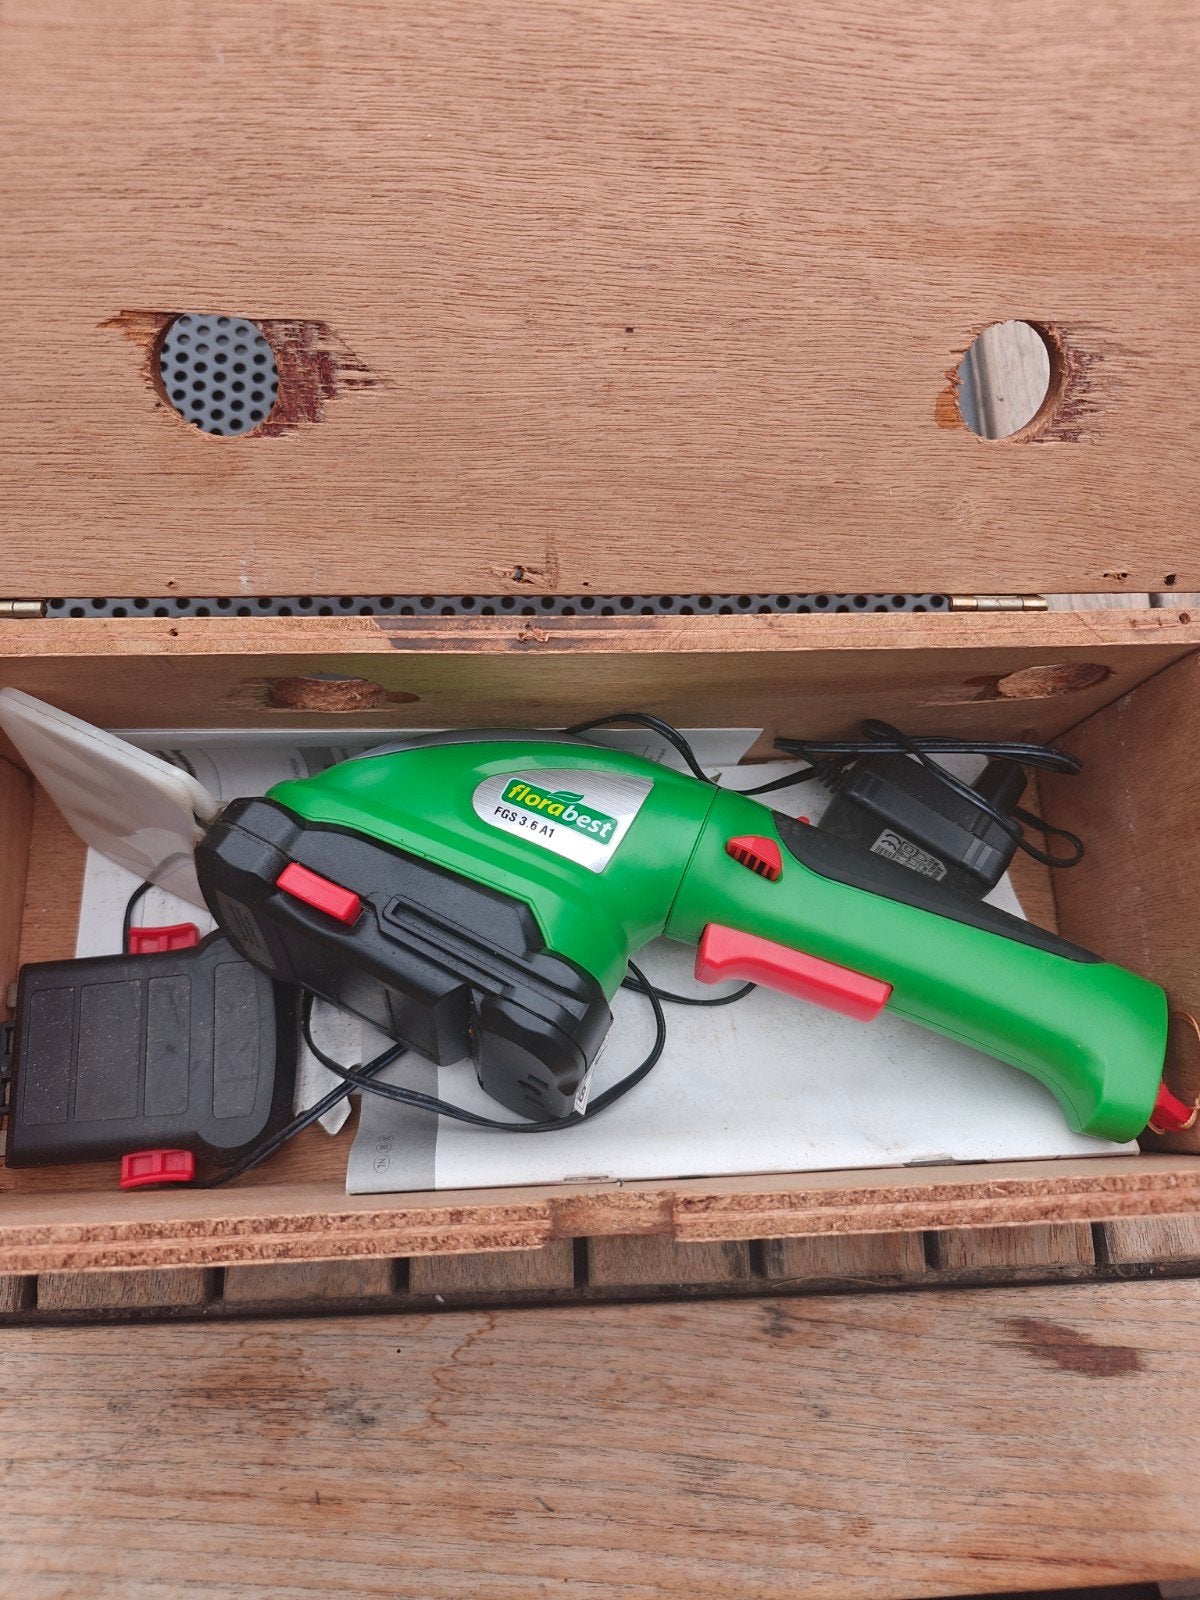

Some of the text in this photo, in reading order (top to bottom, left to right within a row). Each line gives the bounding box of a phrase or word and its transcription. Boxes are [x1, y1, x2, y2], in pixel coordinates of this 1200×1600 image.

[494, 806, 555, 838] FGS 3.6 A1
[508, 784, 613, 838] florabest
